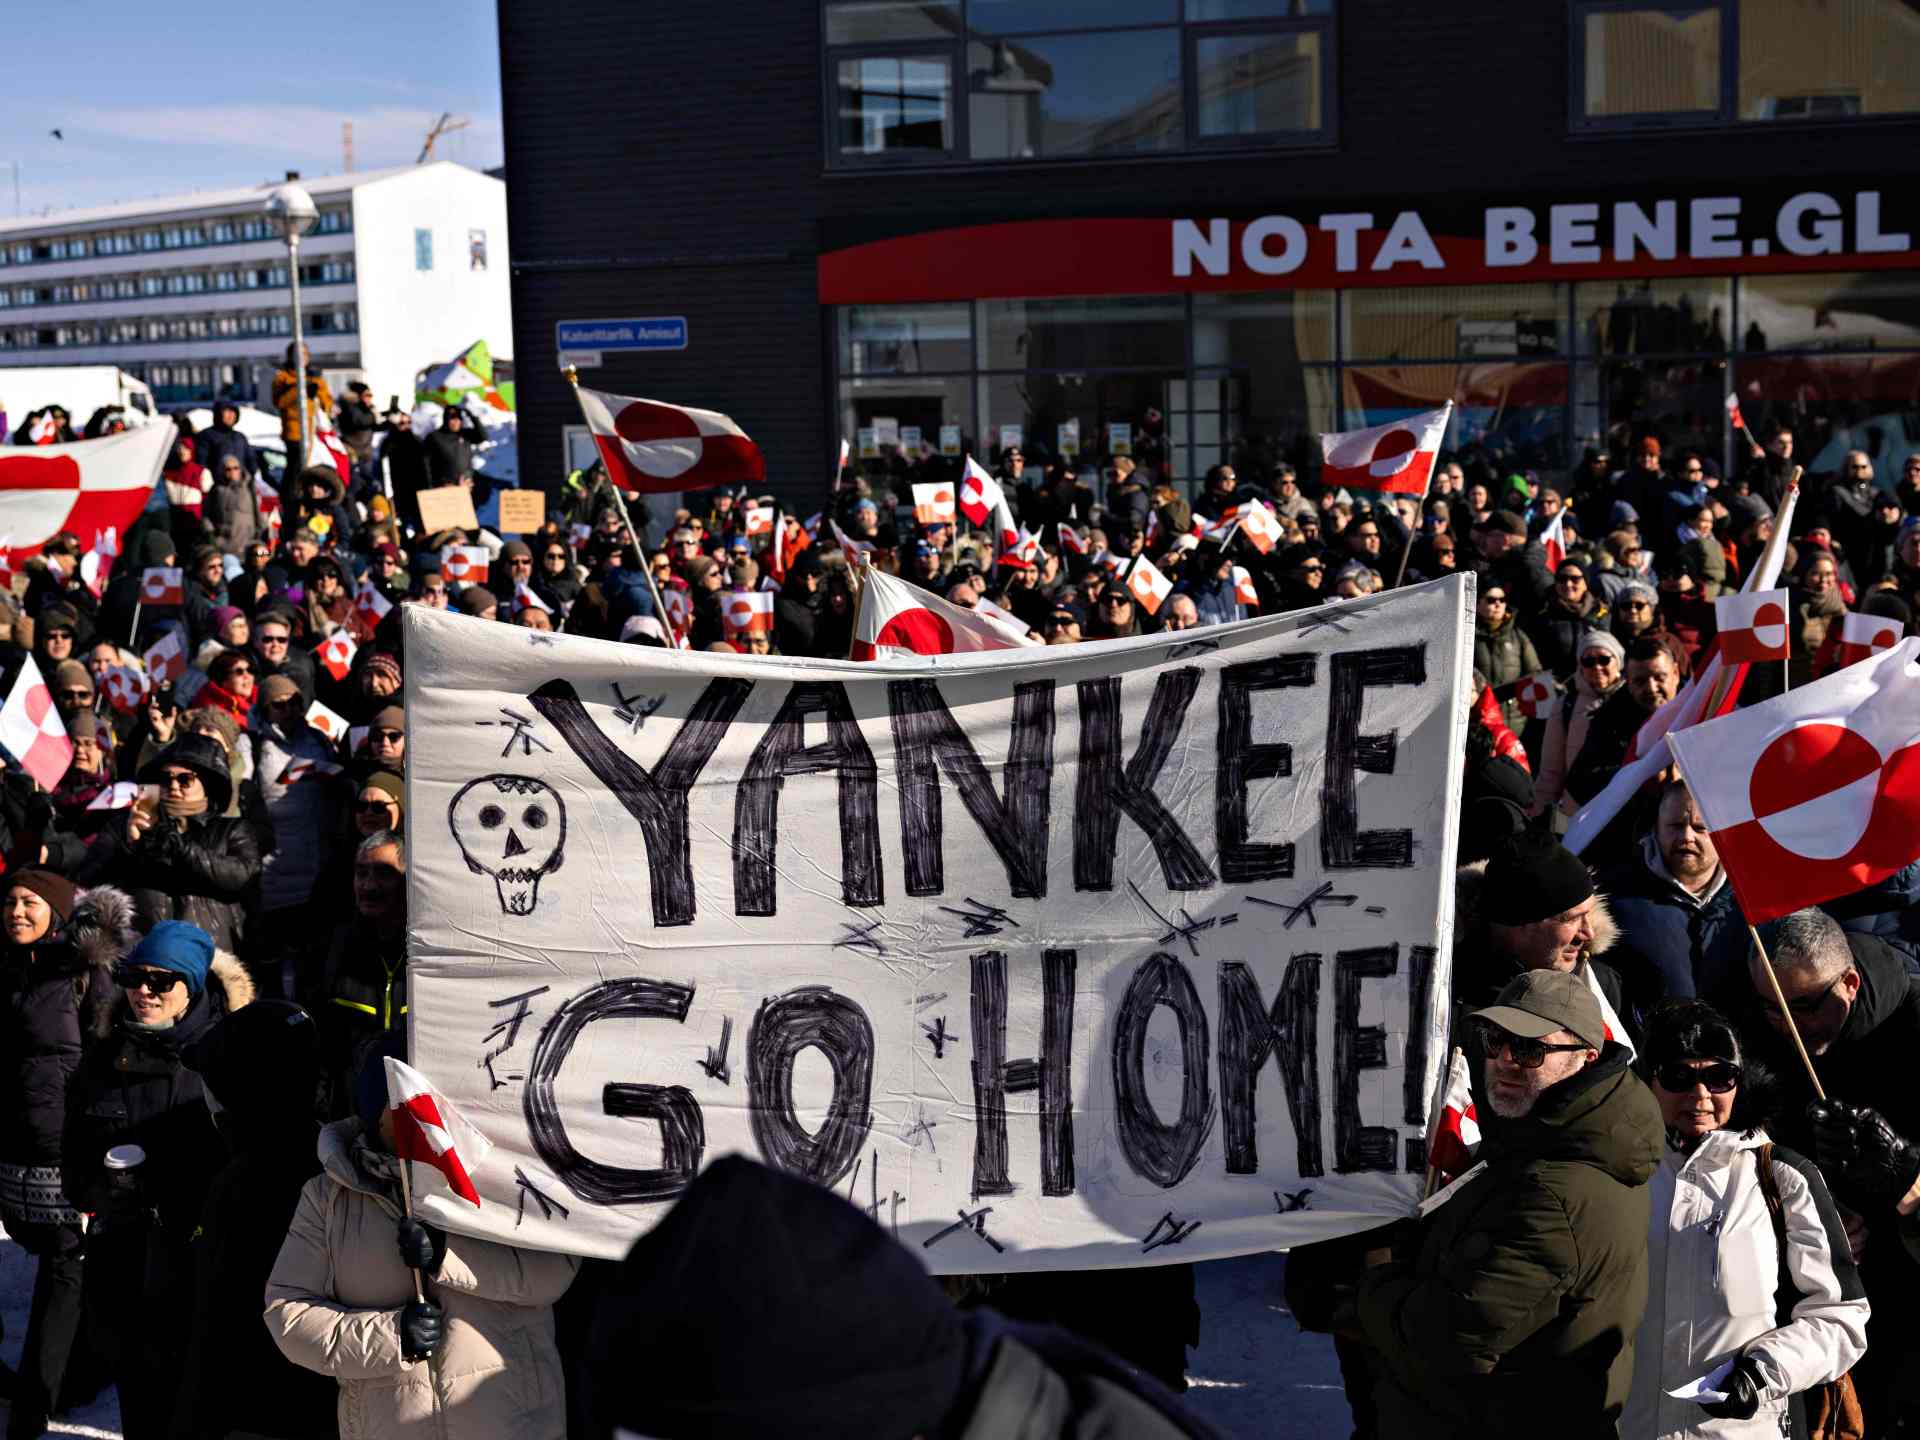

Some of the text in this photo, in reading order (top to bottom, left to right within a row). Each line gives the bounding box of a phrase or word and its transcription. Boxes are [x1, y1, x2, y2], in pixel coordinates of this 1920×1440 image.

[1172, 191, 1911, 277] NOTA BENE.GL
[527, 644, 1427, 927] YANKEE
[523, 942, 1438, 1204] GO HOME!
